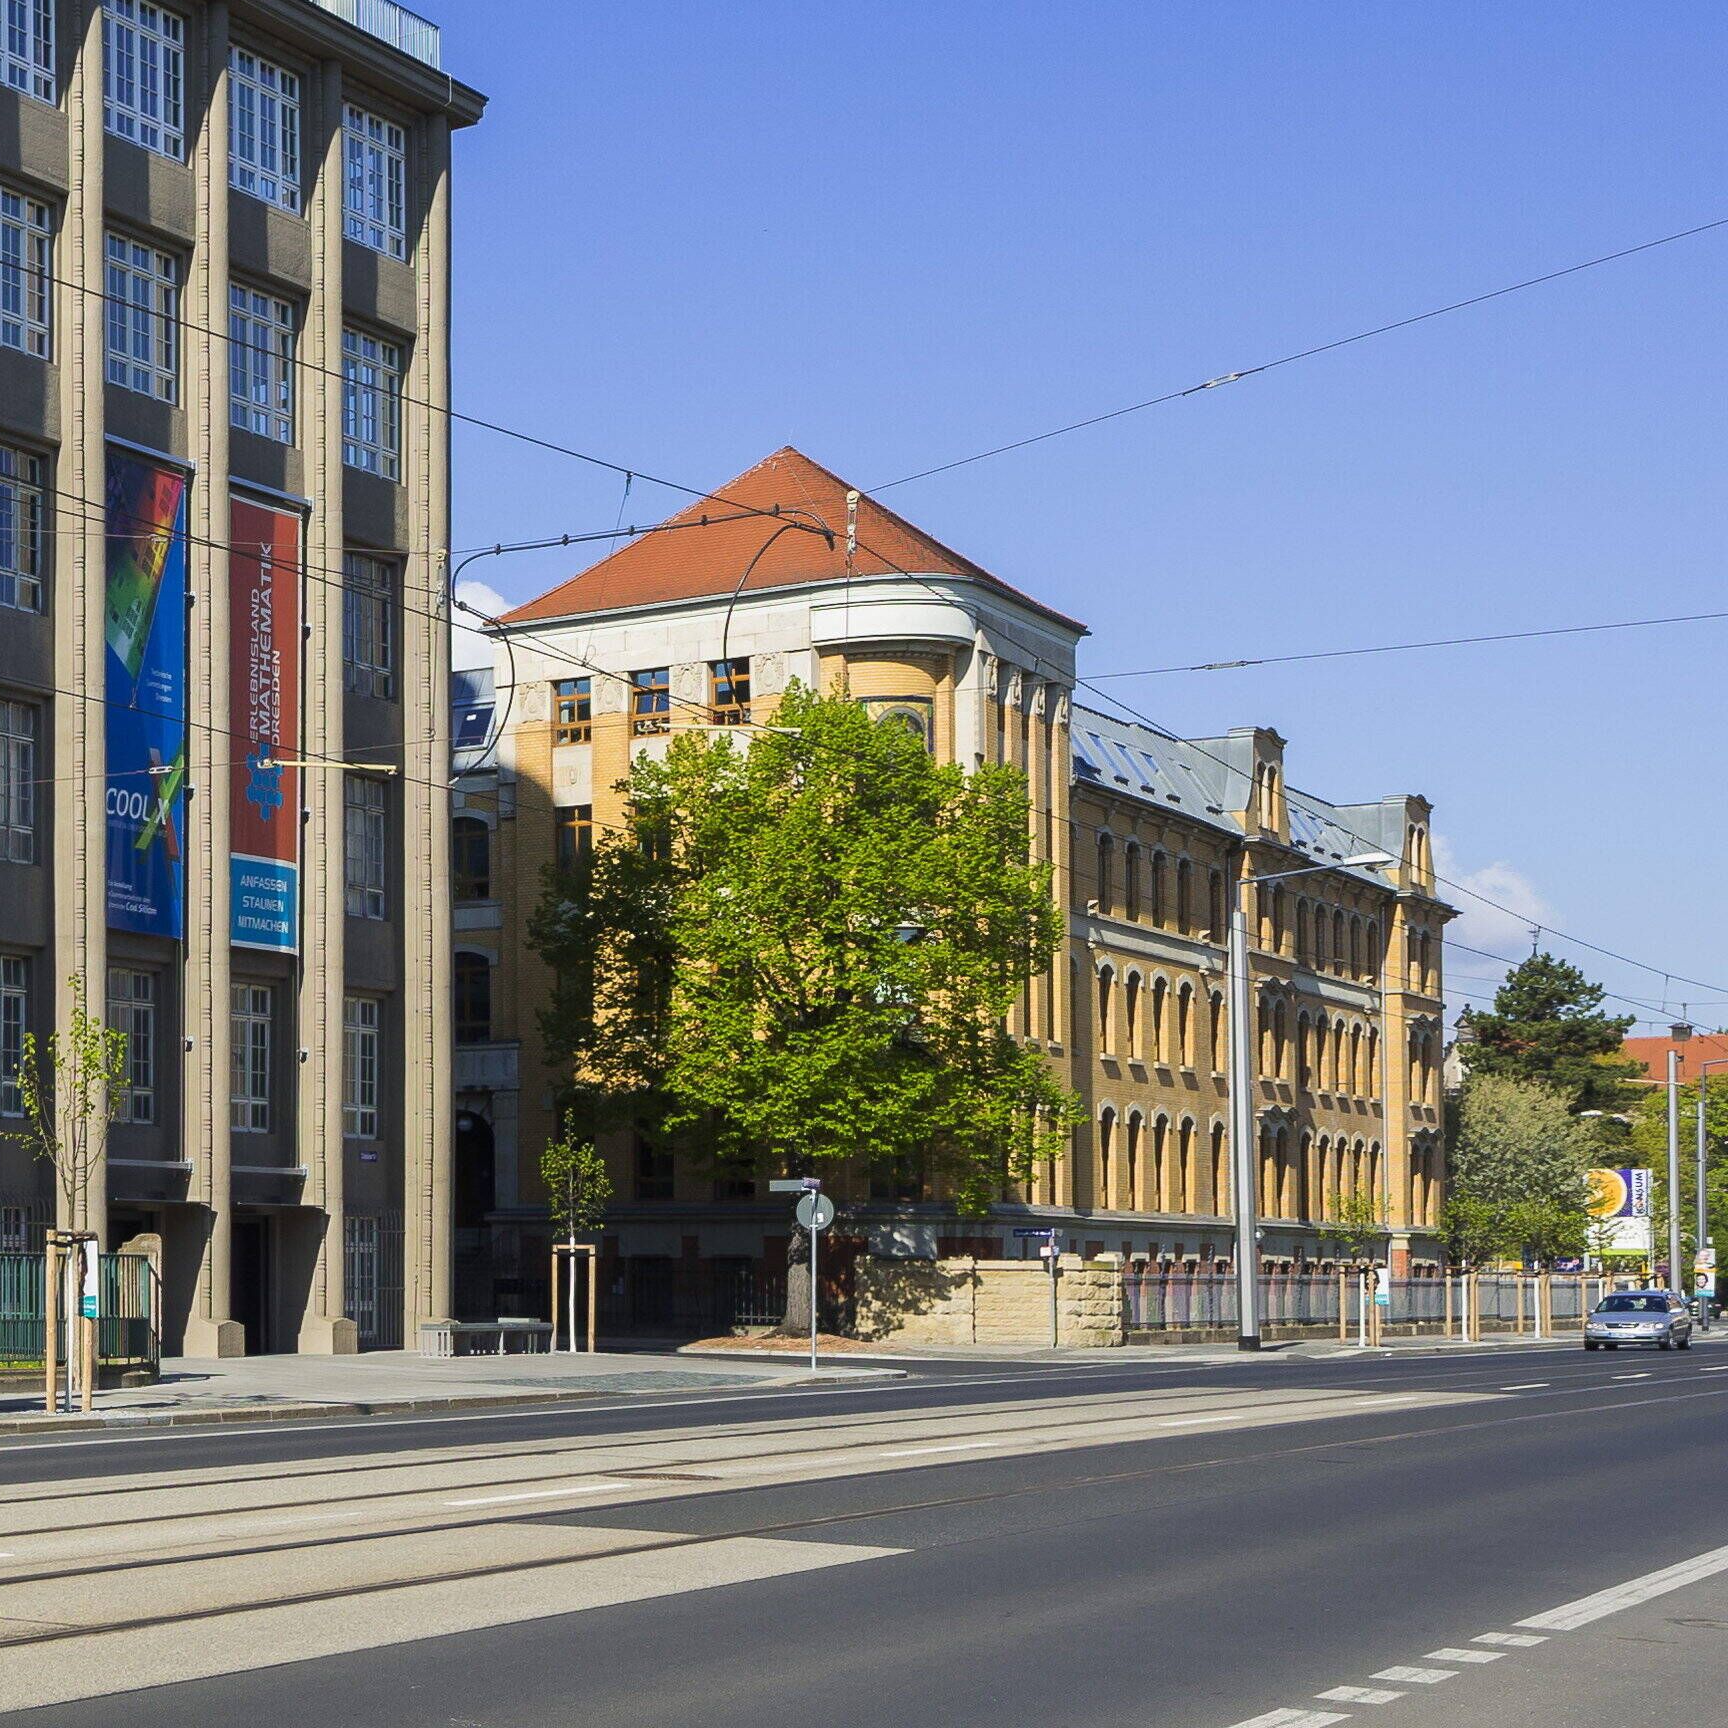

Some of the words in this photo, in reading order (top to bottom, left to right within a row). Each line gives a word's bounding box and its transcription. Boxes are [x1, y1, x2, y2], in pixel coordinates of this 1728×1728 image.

[259, 542, 273, 736] MATHEMATIK
[249, 588, 260, 744] ERLEBNISLAND
[272, 650, 281, 746] DRESDEN
[106, 787, 150, 822] COOL
[240, 875, 287, 892] ANFASSEN
[242, 895, 284, 912] STAUNEN
[238, 915, 289, 934] MITMACHEN
